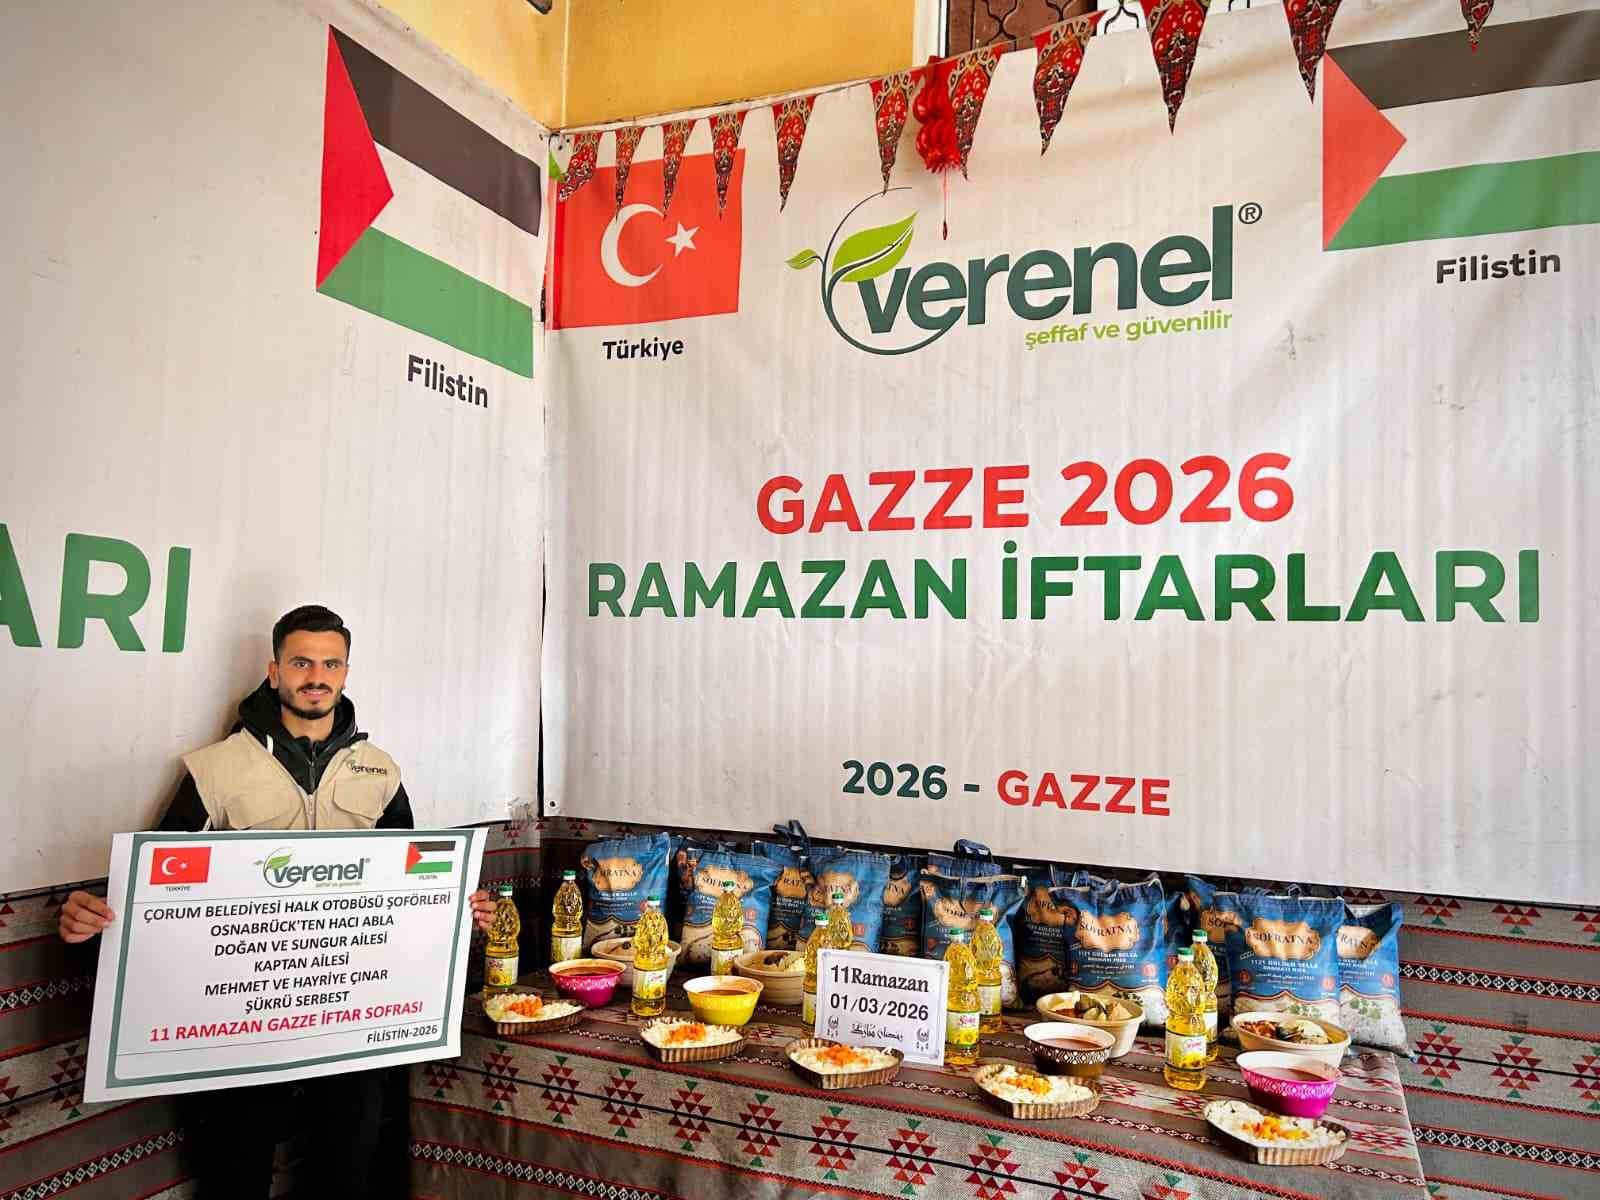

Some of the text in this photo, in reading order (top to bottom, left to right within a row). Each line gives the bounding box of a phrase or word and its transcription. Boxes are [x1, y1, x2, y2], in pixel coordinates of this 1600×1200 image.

[857, 204, 1233, 334] verenel
[1436, 249, 1561, 284] Filistin
[1025, 310, 1233, 350] şeffaf ve güvenilir
[602, 337, 684, 361] Türkiye
[407, 354, 488, 408] Filistin
[756, 452, 1294, 535] GAZZE 2026
[588, 540, 1540, 623] RAMAZAN İFTARLARI
[842, 760, 948, 800] 2026
[997, 770, 1170, 816] GAZZE
[272, 858, 365, 883] verenel
[144, 891, 451, 923] ÇORUM BELEDİYESİ HALK OTOBÜSÜ ŞOFÖRLERİ
[210, 915, 394, 936] OSNABRÜCK'TEN HACI ABLA
[1253, 930, 1314, 945] SOFRATNA
[214, 933, 388, 956] DOĞAN VE SUNGUR AİLESİ
[254, 952, 349, 972] KAPTAN AİLESİ
[204, 969, 388, 996] MEHMET VE HAYRİYE ÇINAR
[245, 991, 350, 1014] ŞÜKRÜ SERBEST
[830, 993, 929, 1021] 01/03/2026
[150, 1001, 423, 1042] 11 RAMAZAN GAZZE İFTAR SOFRASI
[367, 1024, 438, 1043] FİLİSTİN-2026
